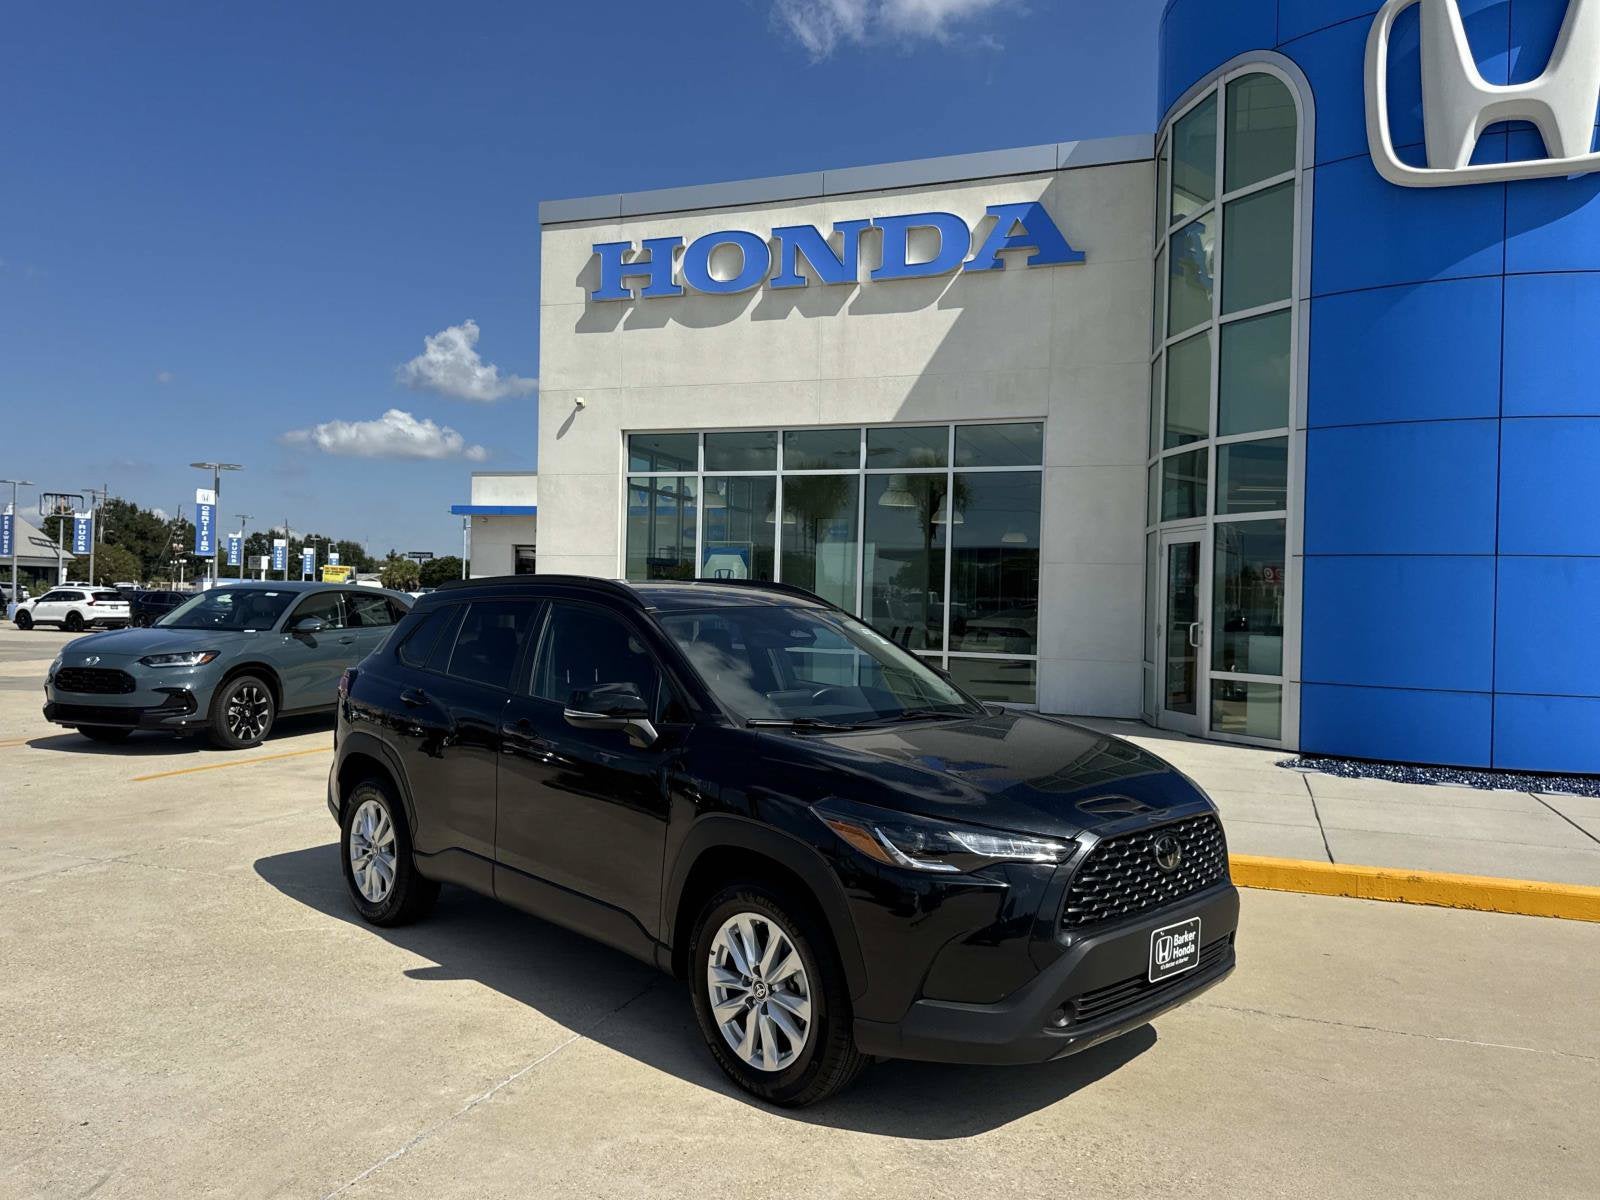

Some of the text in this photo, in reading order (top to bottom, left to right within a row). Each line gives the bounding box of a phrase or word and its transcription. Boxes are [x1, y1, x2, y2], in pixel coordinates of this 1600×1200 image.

[591, 201, 1086, 302] HONDA
[77, 519, 87, 551] TRUCKS
[201, 505, 210, 552] CERTIFIED
[1173, 942, 1195, 959] Honda
[1174, 930, 1197, 946] Barker
